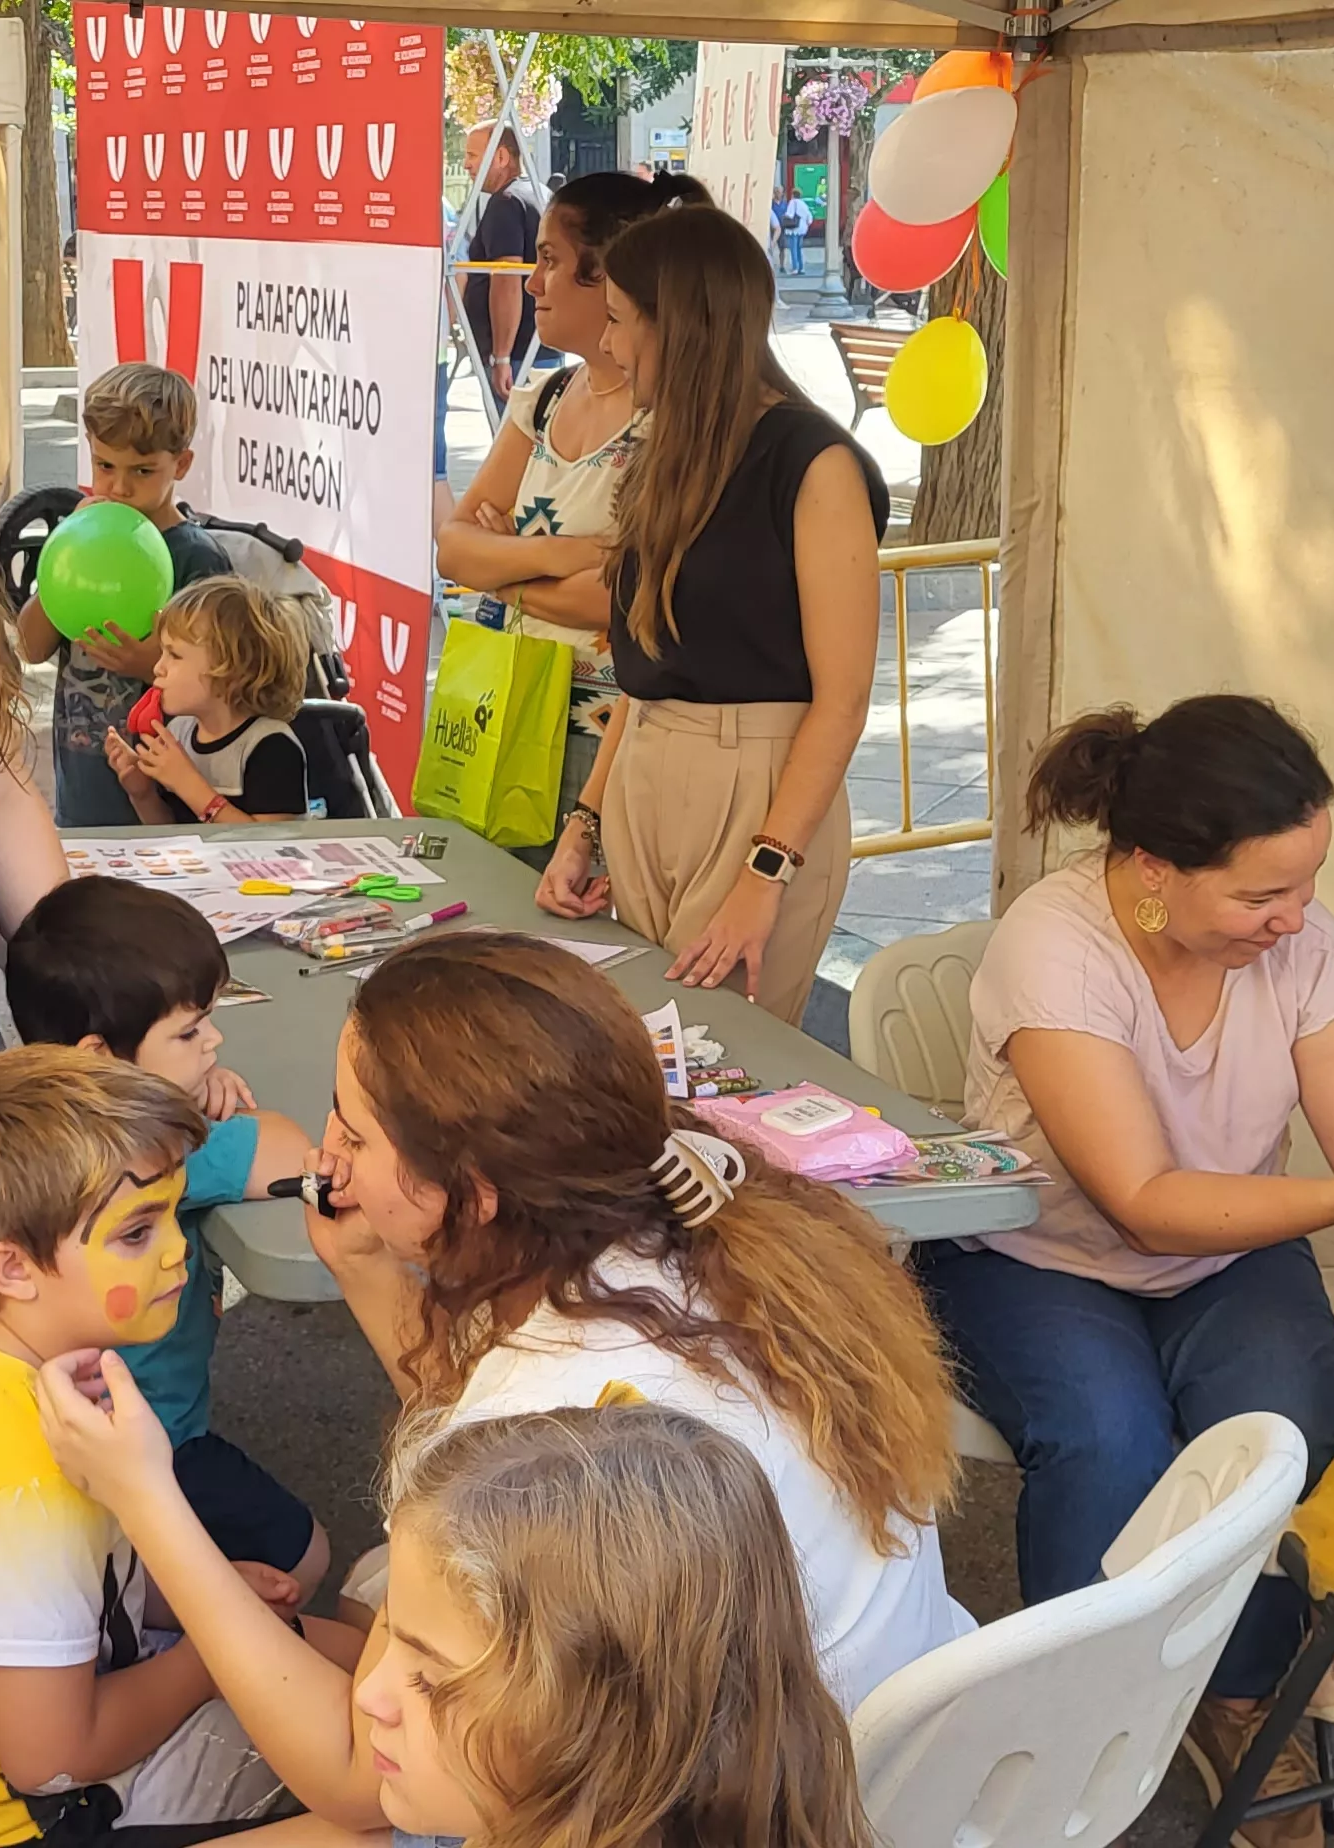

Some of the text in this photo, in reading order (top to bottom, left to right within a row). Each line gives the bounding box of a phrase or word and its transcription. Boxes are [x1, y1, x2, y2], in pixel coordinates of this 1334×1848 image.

[236, 281, 351, 344] PLATAFORMA
[209, 355, 382, 436] DEL VOLUNTARIADO
[238, 437, 342, 512] DE ARAGÓN
[433, 707, 479, 758] Huellas
